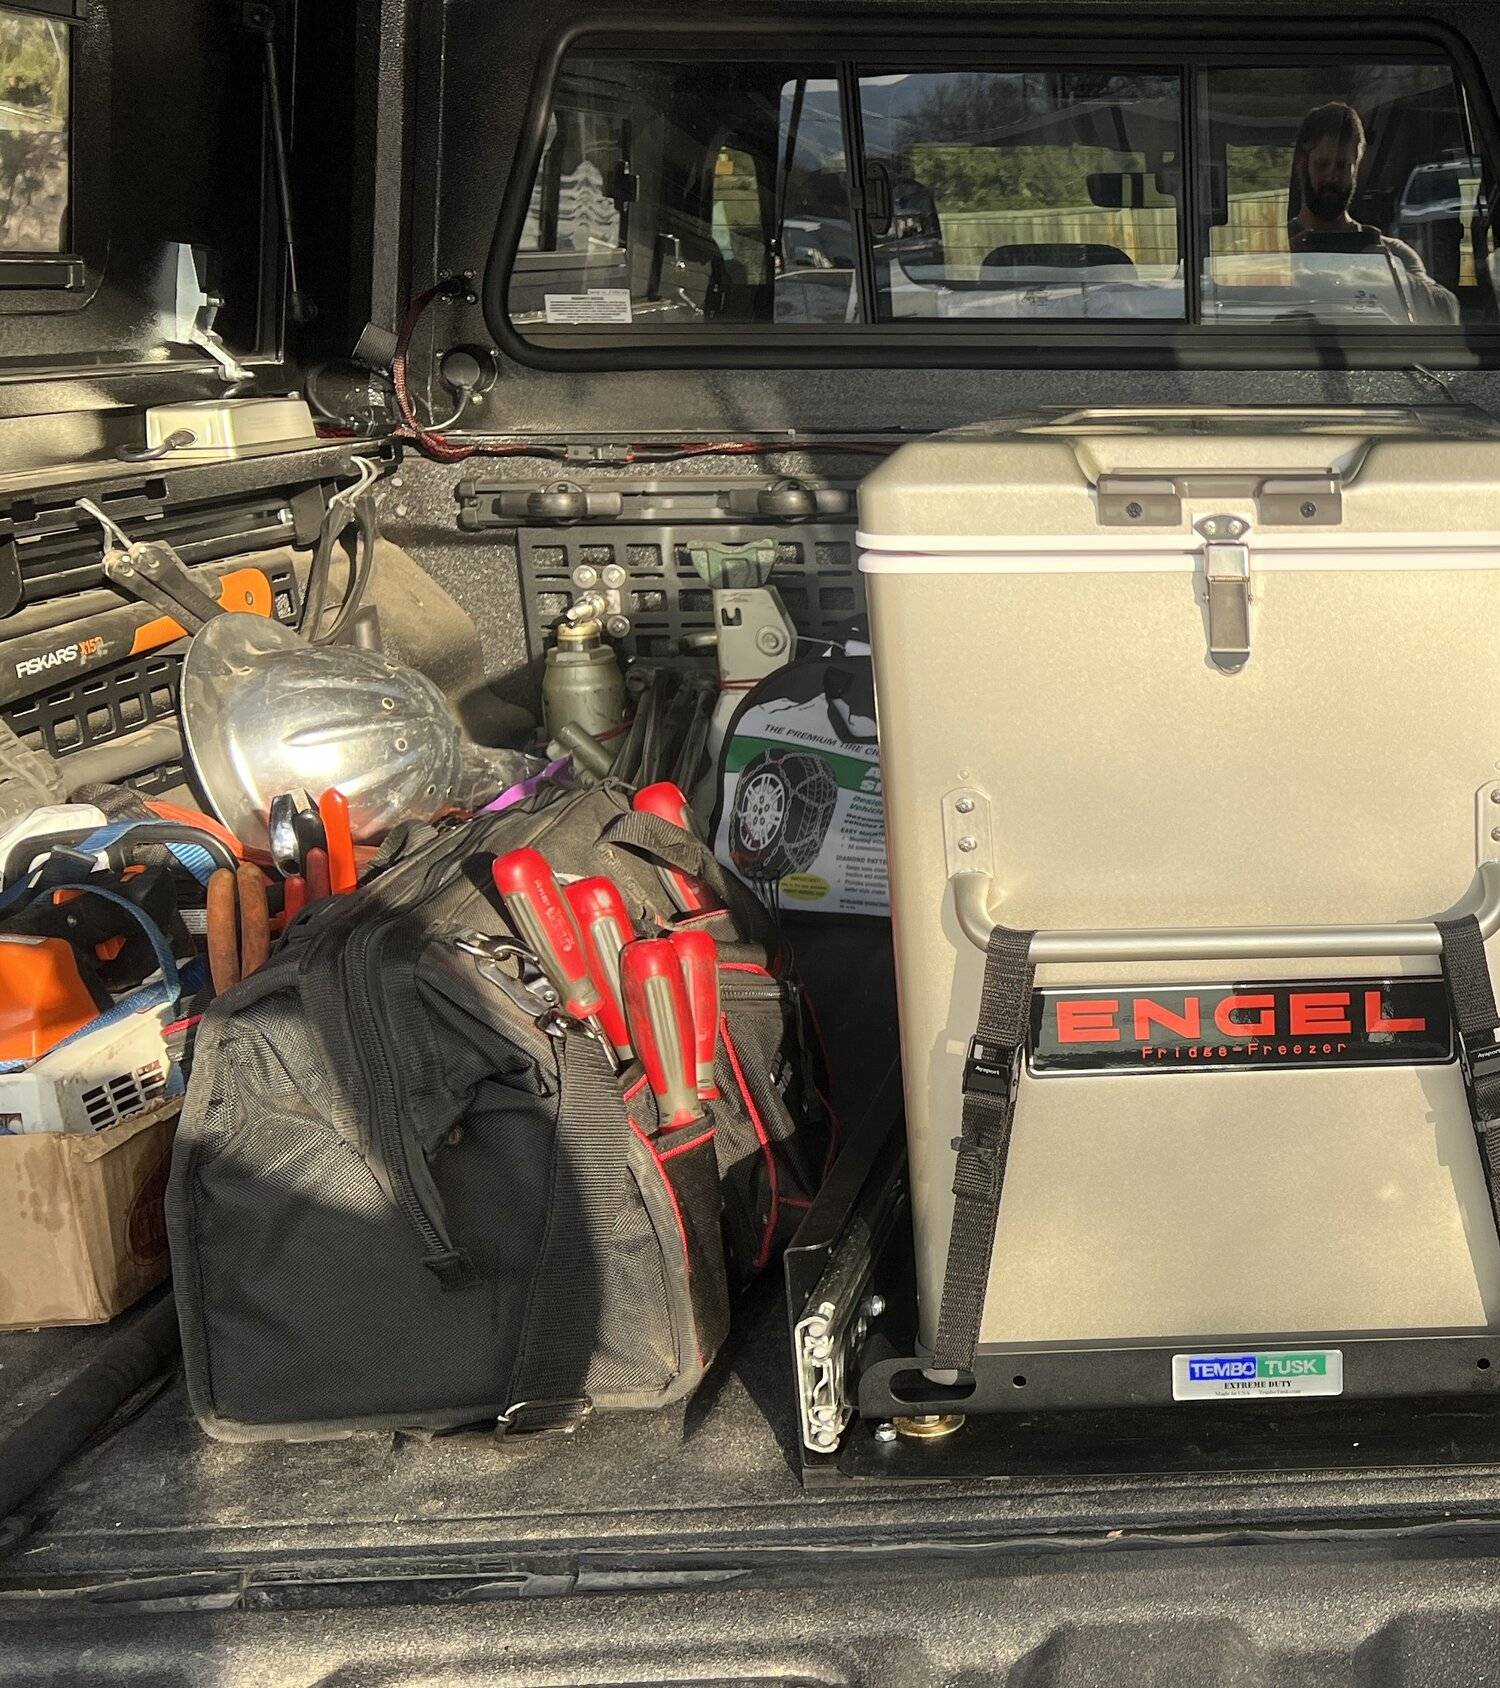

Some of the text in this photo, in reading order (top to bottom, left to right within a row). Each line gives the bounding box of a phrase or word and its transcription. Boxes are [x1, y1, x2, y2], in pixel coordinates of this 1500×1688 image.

[15, 644, 79, 679] FISKARS
[765, 724, 785, 736] THE
[786, 728, 837, 746] PREMIUM
[840, 740, 863, 753] TIRE
[1056, 991, 1426, 1043] ENGEL
[1141, 1043, 1347, 1060] Fridge-Freezer
[1191, 1359, 1318, 1378] TEMBO TUSK
[1268, 1380, 1293, 1388] DUTY
